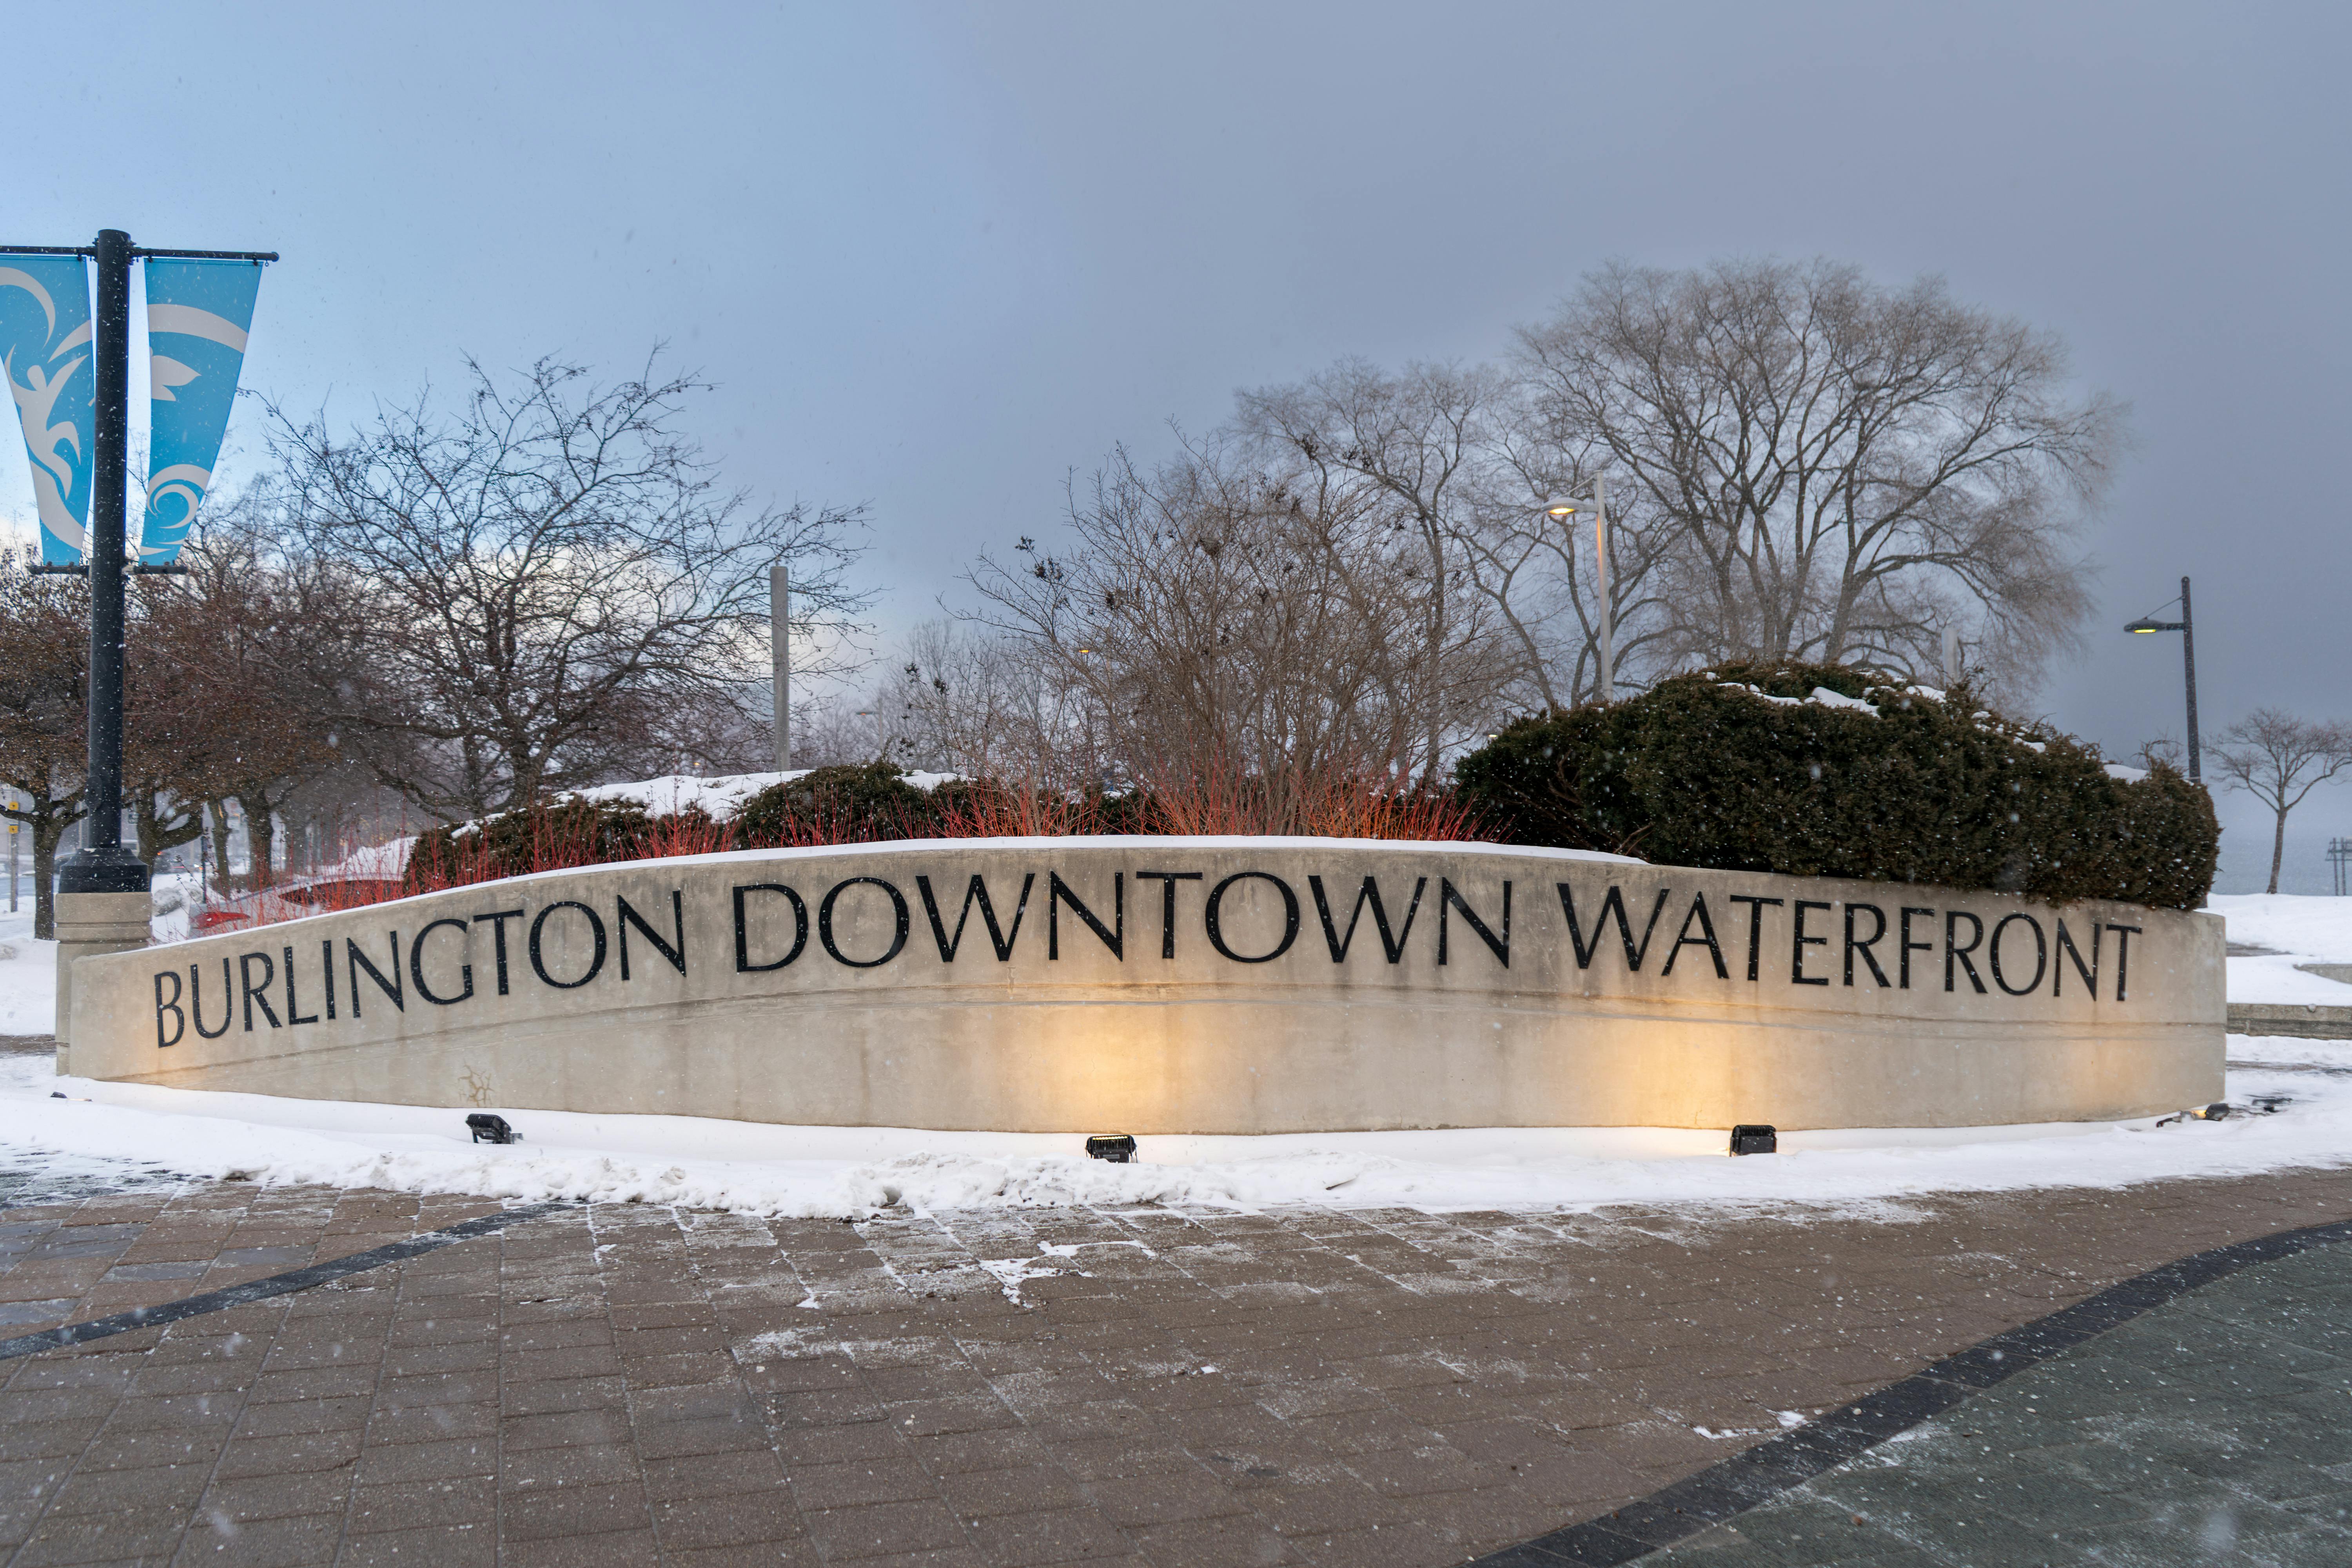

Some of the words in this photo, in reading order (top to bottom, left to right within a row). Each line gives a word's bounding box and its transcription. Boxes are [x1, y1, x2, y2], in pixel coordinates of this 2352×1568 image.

[154, 890, 687, 1048] BURLINGTON
[732, 871, 1512, 972] DOWNTOWN
[1557, 882, 2142, 1001] WATERFRONT
